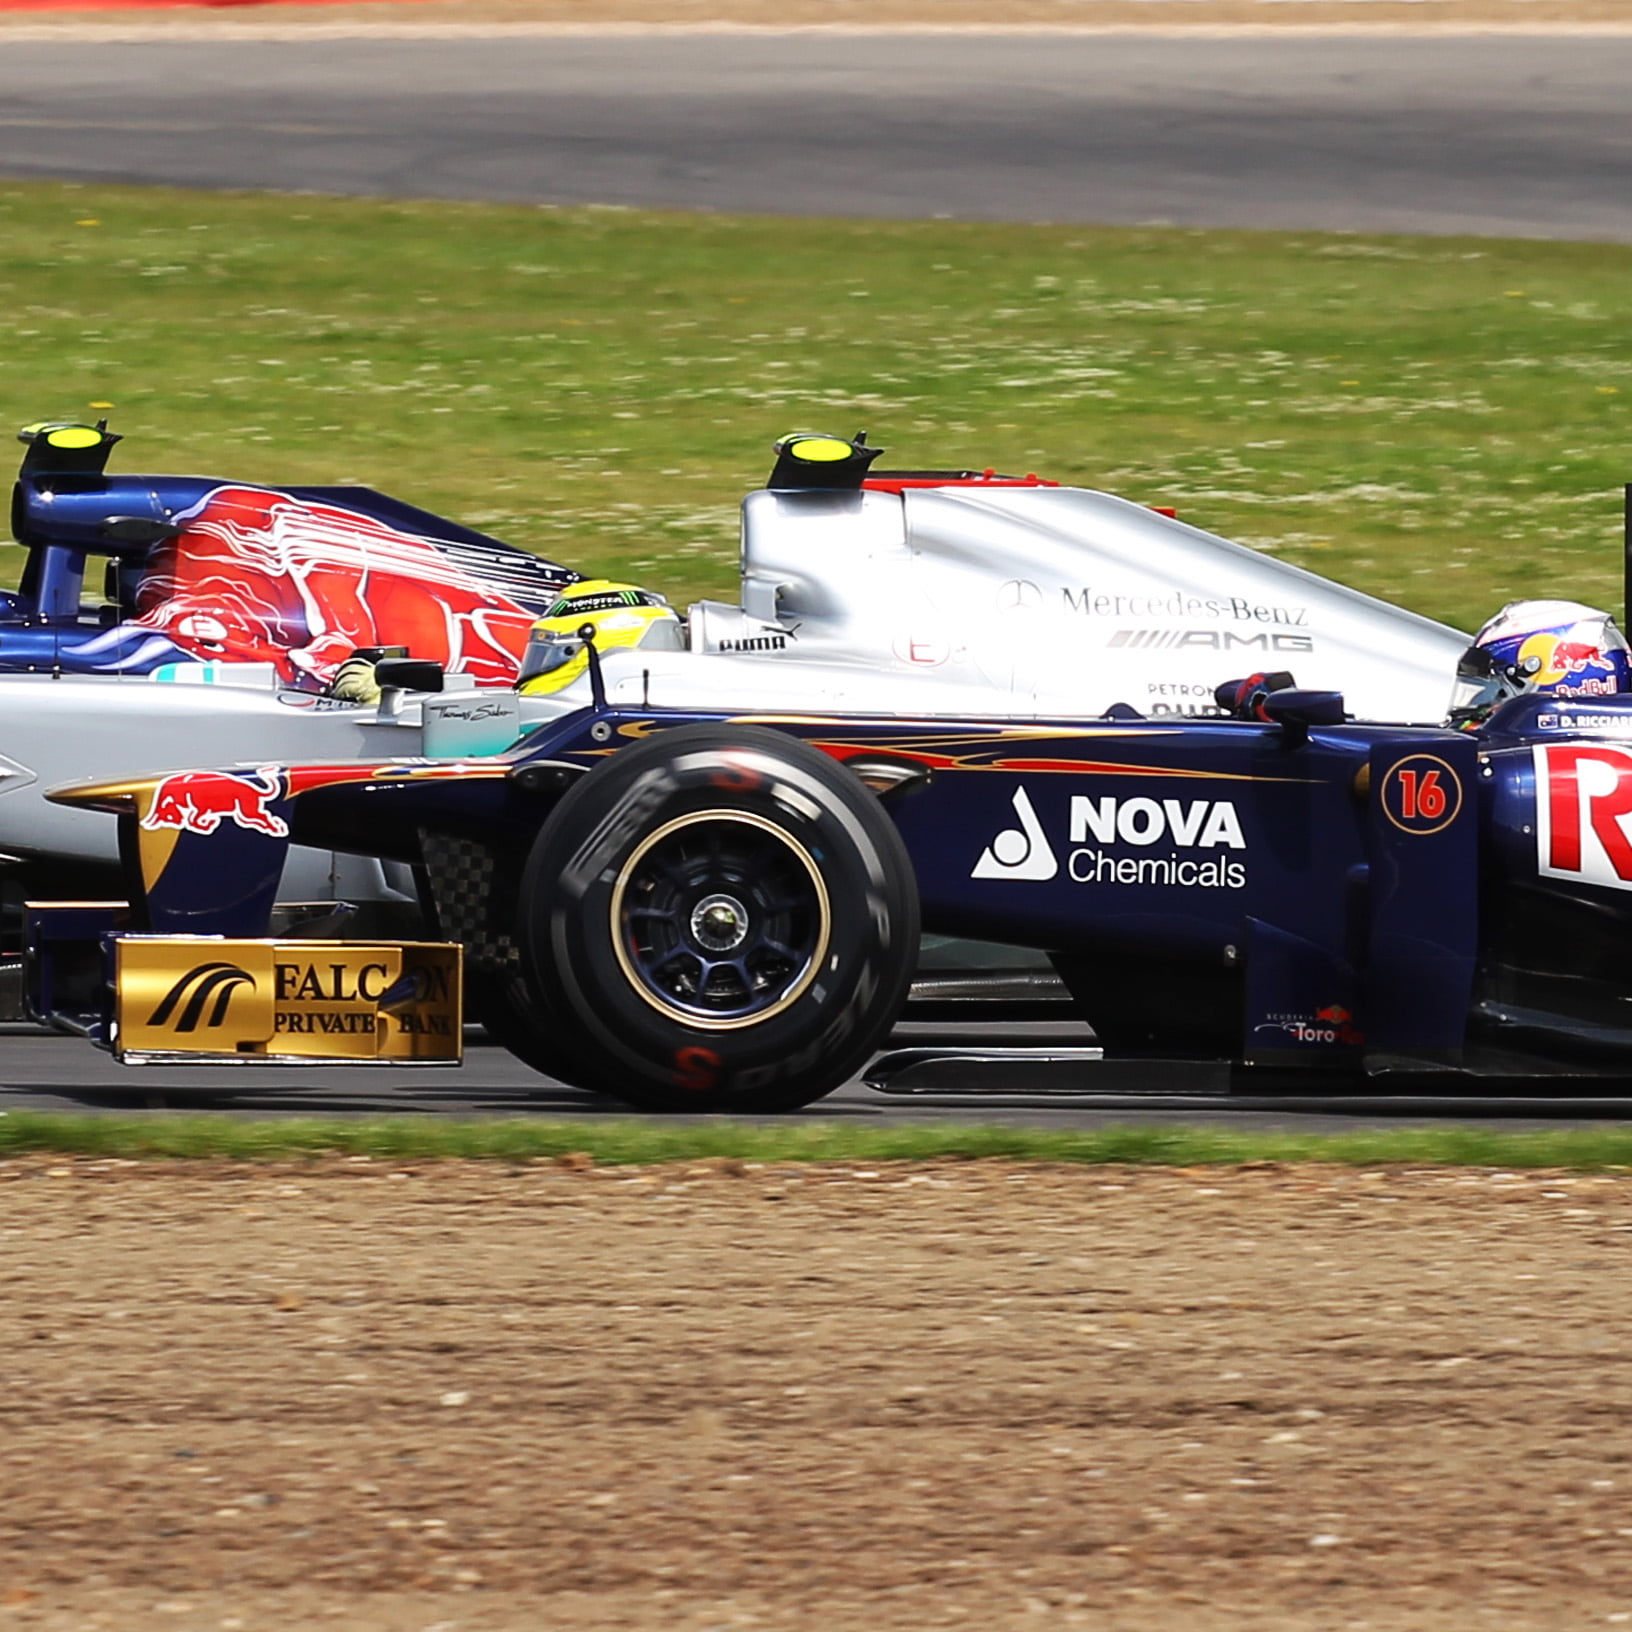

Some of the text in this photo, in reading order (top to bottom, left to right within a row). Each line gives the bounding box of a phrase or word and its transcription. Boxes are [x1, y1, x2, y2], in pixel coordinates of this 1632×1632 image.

[1061, 586, 1310, 627] Mercedes-Benz
[719, 635, 786, 653] PUMA
[1173, 630, 1314, 653] AMG
[1398, 770, 1446, 819] 16
[1070, 795, 1247, 849] NOVA
[1068, 848, 1246, 898] Chemicals
[275, 1011, 453, 1036] PRIVATE BANK
